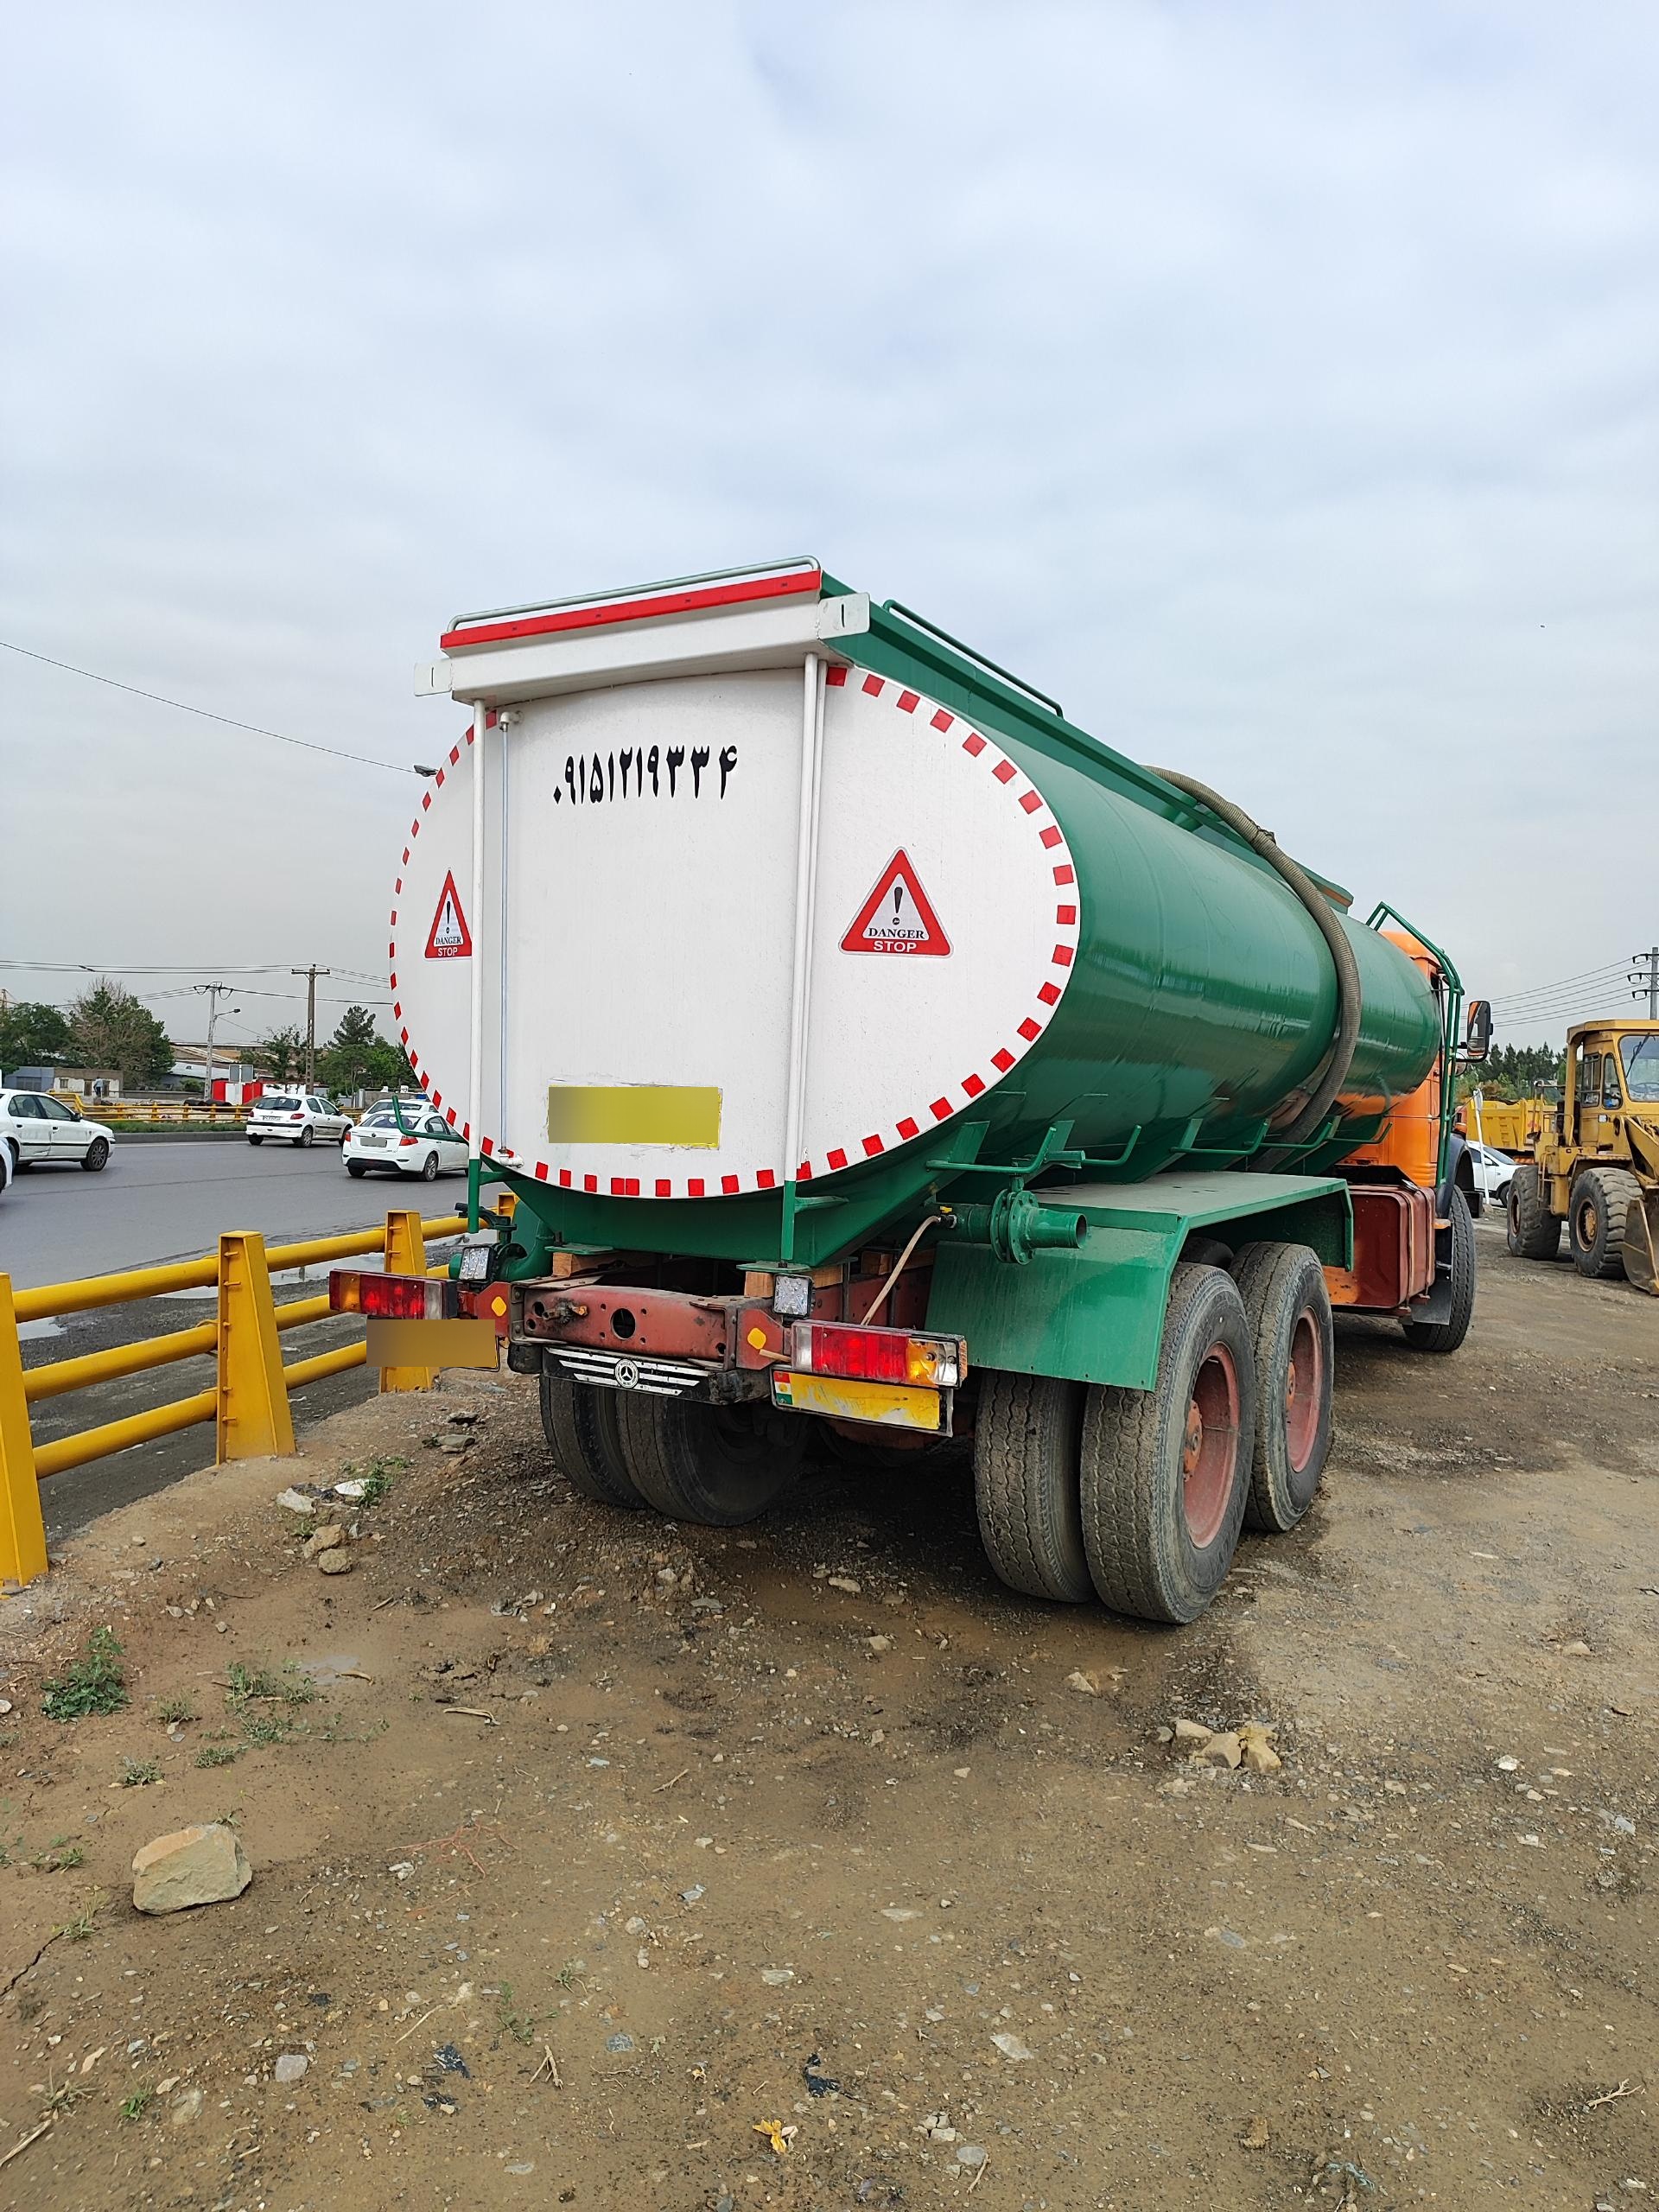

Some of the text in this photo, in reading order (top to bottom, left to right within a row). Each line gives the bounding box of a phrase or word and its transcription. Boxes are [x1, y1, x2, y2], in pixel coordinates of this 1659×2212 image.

[553, 745, 738, 805] ۰۹۱۵۱۲۱۹۳۳۴
[868, 927, 925, 939] DANGER
[435, 936, 462, 944] DANGER
[873, 940, 917, 952] STOP
[437, 947, 458, 957] STOP
